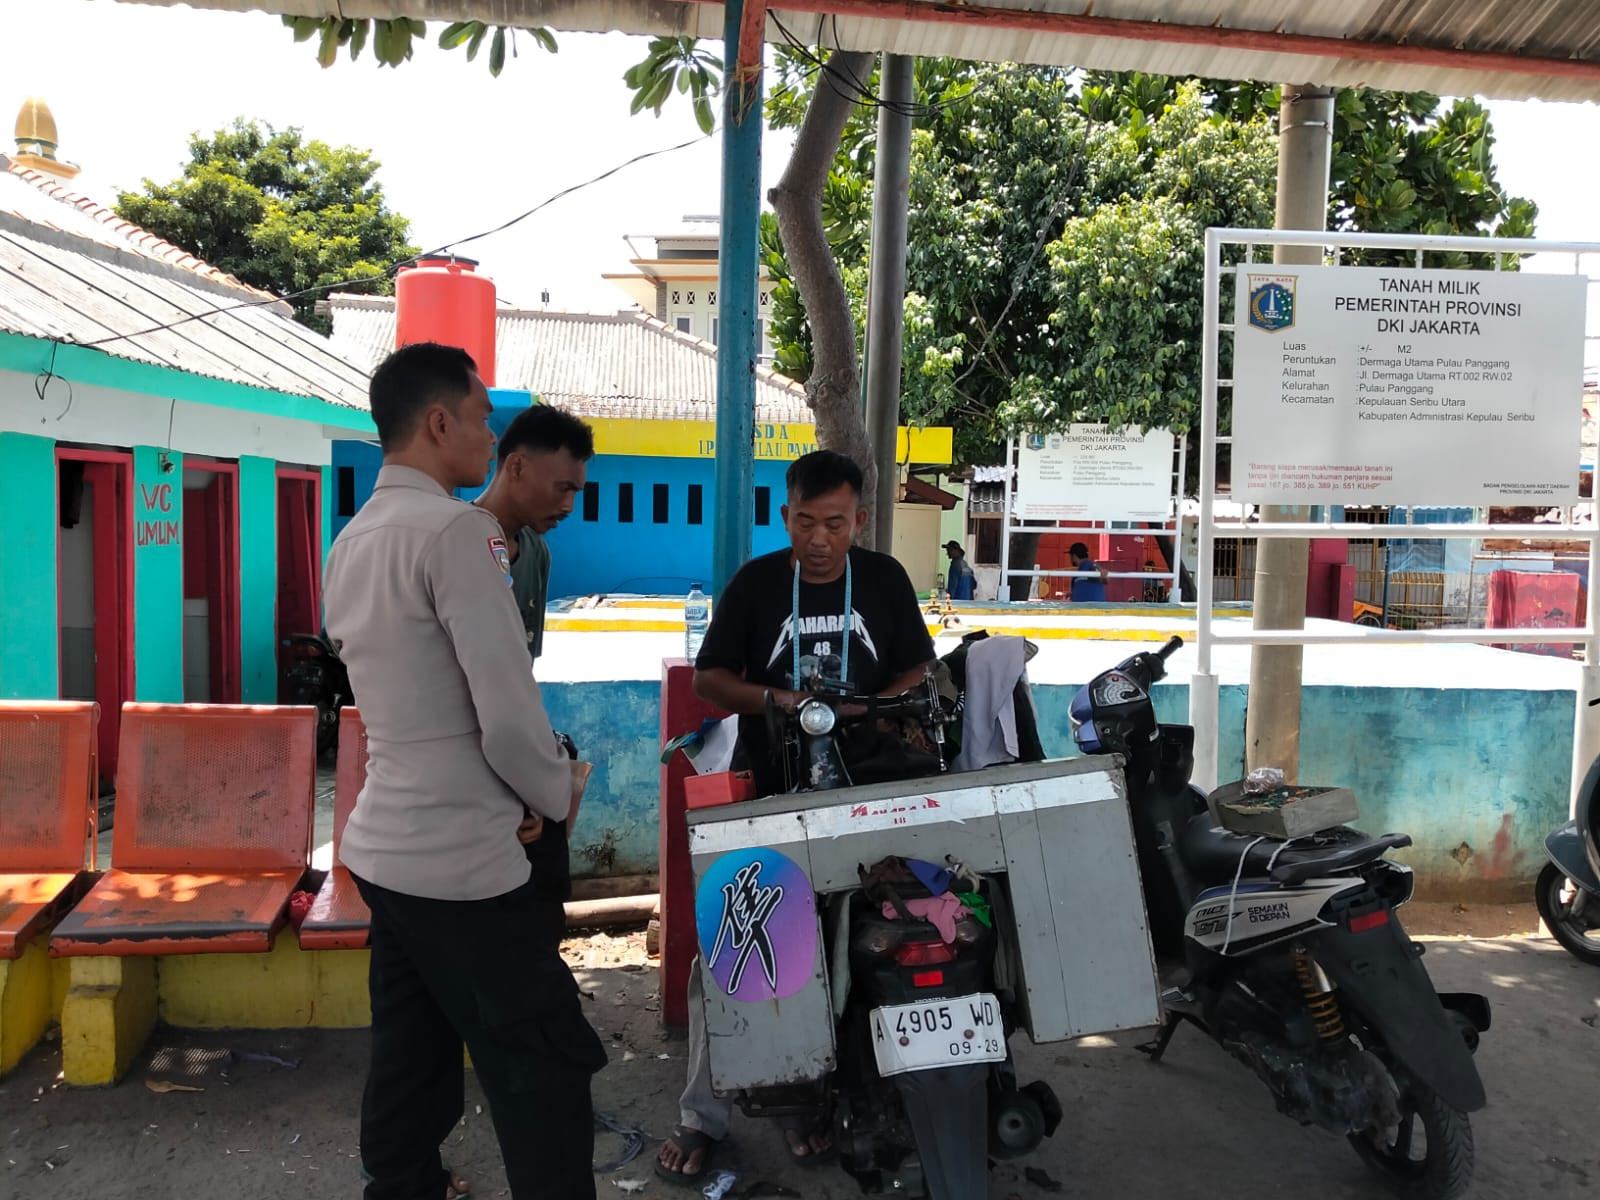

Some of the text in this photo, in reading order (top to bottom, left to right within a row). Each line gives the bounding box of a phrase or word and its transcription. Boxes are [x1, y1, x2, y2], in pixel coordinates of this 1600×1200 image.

[1379, 278, 1480, 296] TANAH MILIK
[1335, 297, 1521, 317] PEMERINTAH PROVINSI
[1377, 318, 1480, 336] DKI JAKARTA
[1283, 341, 1306, 351] Luas
[1397, 344, 1412, 355] M2
[1283, 354, 1336, 365] Peruntukan
[1404, 359, 1434, 368] Utama
[1436, 358, 1462, 368] Pulau
[1465, 359, 1510, 370] Panggang
[1282, 367, 1315, 378] Alamat
[1372, 371, 1414, 382] Dermaga
[1416, 372, 1446, 381] Utama
[1281, 381, 1330, 391] Kelurahan
[1388, 384, 1434, 395] Panggang
[1281, 394, 1335, 404] Kecamatan
[1409, 398, 1438, 407] Seribu
[1441, 398, 1466, 407] Utara
[1358, 411, 1408, 422] Kabupaten
[1410, 412, 1464, 422] Administrasi
[1506, 412, 1536, 422] Seribu
[1094, 444, 1127, 452] JAKARTA
[141, 483, 172, 513] WC
[137, 520, 180, 546] UMUM
[813, 641, 832, 656] 48
[1248, 902, 1288, 916] SEMAKIN
[1258, 911, 1290, 922] DEPAN
[876, 1002, 994, 1043] A 4905 WD
